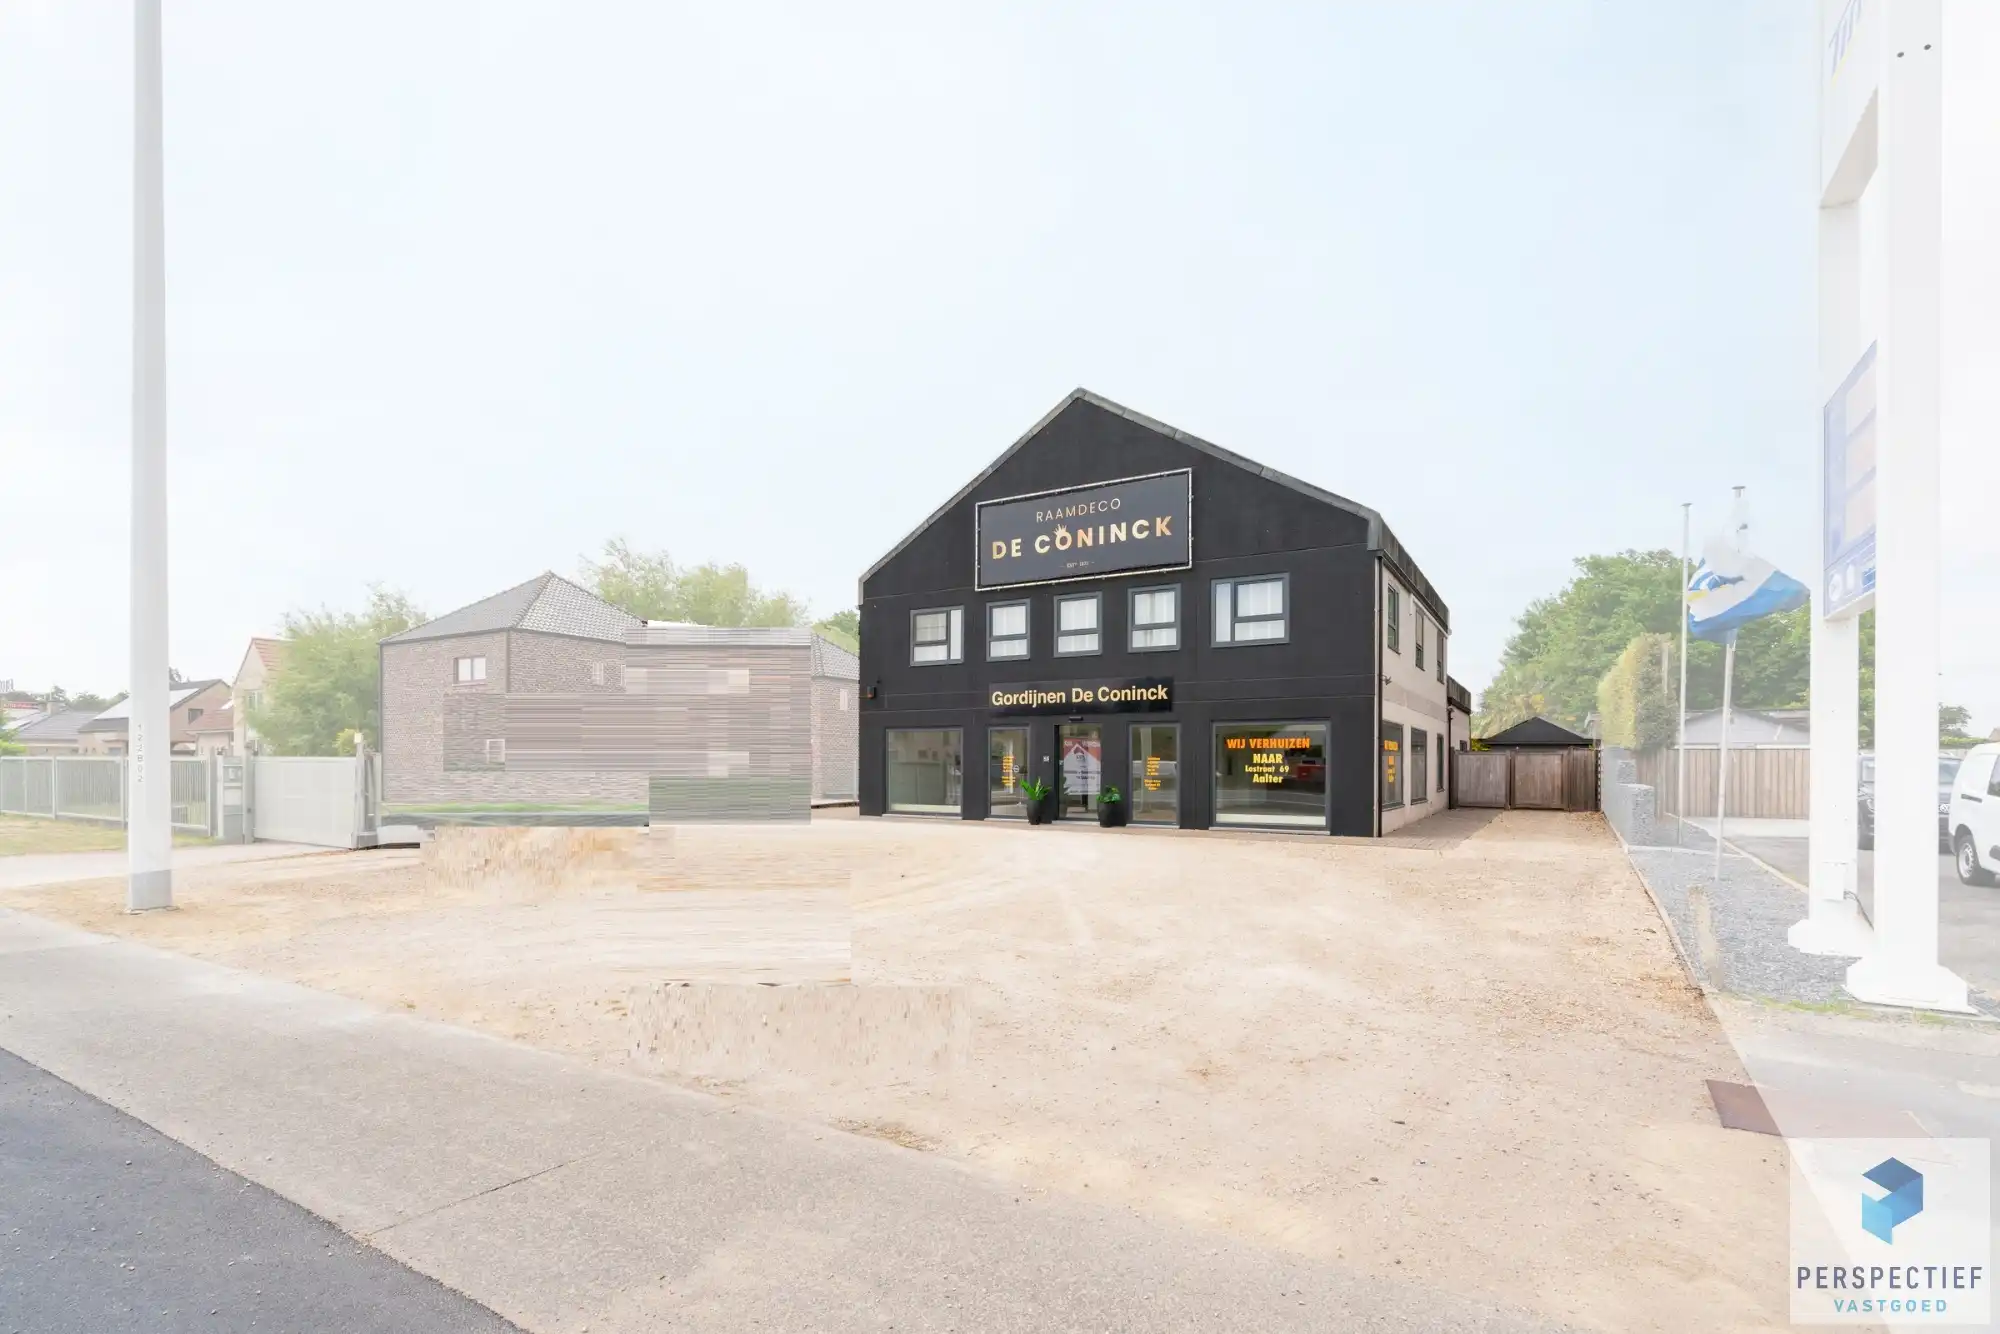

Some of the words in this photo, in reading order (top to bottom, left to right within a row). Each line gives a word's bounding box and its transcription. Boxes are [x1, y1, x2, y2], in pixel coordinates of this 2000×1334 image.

[1036, 498, 1121, 523] RAAMDECO
[991, 538, 1022, 559] DE
[1035, 516, 1172, 553] CONINCK
[991, 690, 1065, 708] Gordijnen
[1072, 688, 1093, 703] De
[1098, 685, 1168, 701] Coninck
[1226, 738, 1246, 749] WIJ
[1249, 738, 1310, 749] VERHUIZEN
[1252, 753, 1283, 764] NAAR
[1279, 765, 1289, 773] 69
[1252, 774, 1283, 783] Aalter
